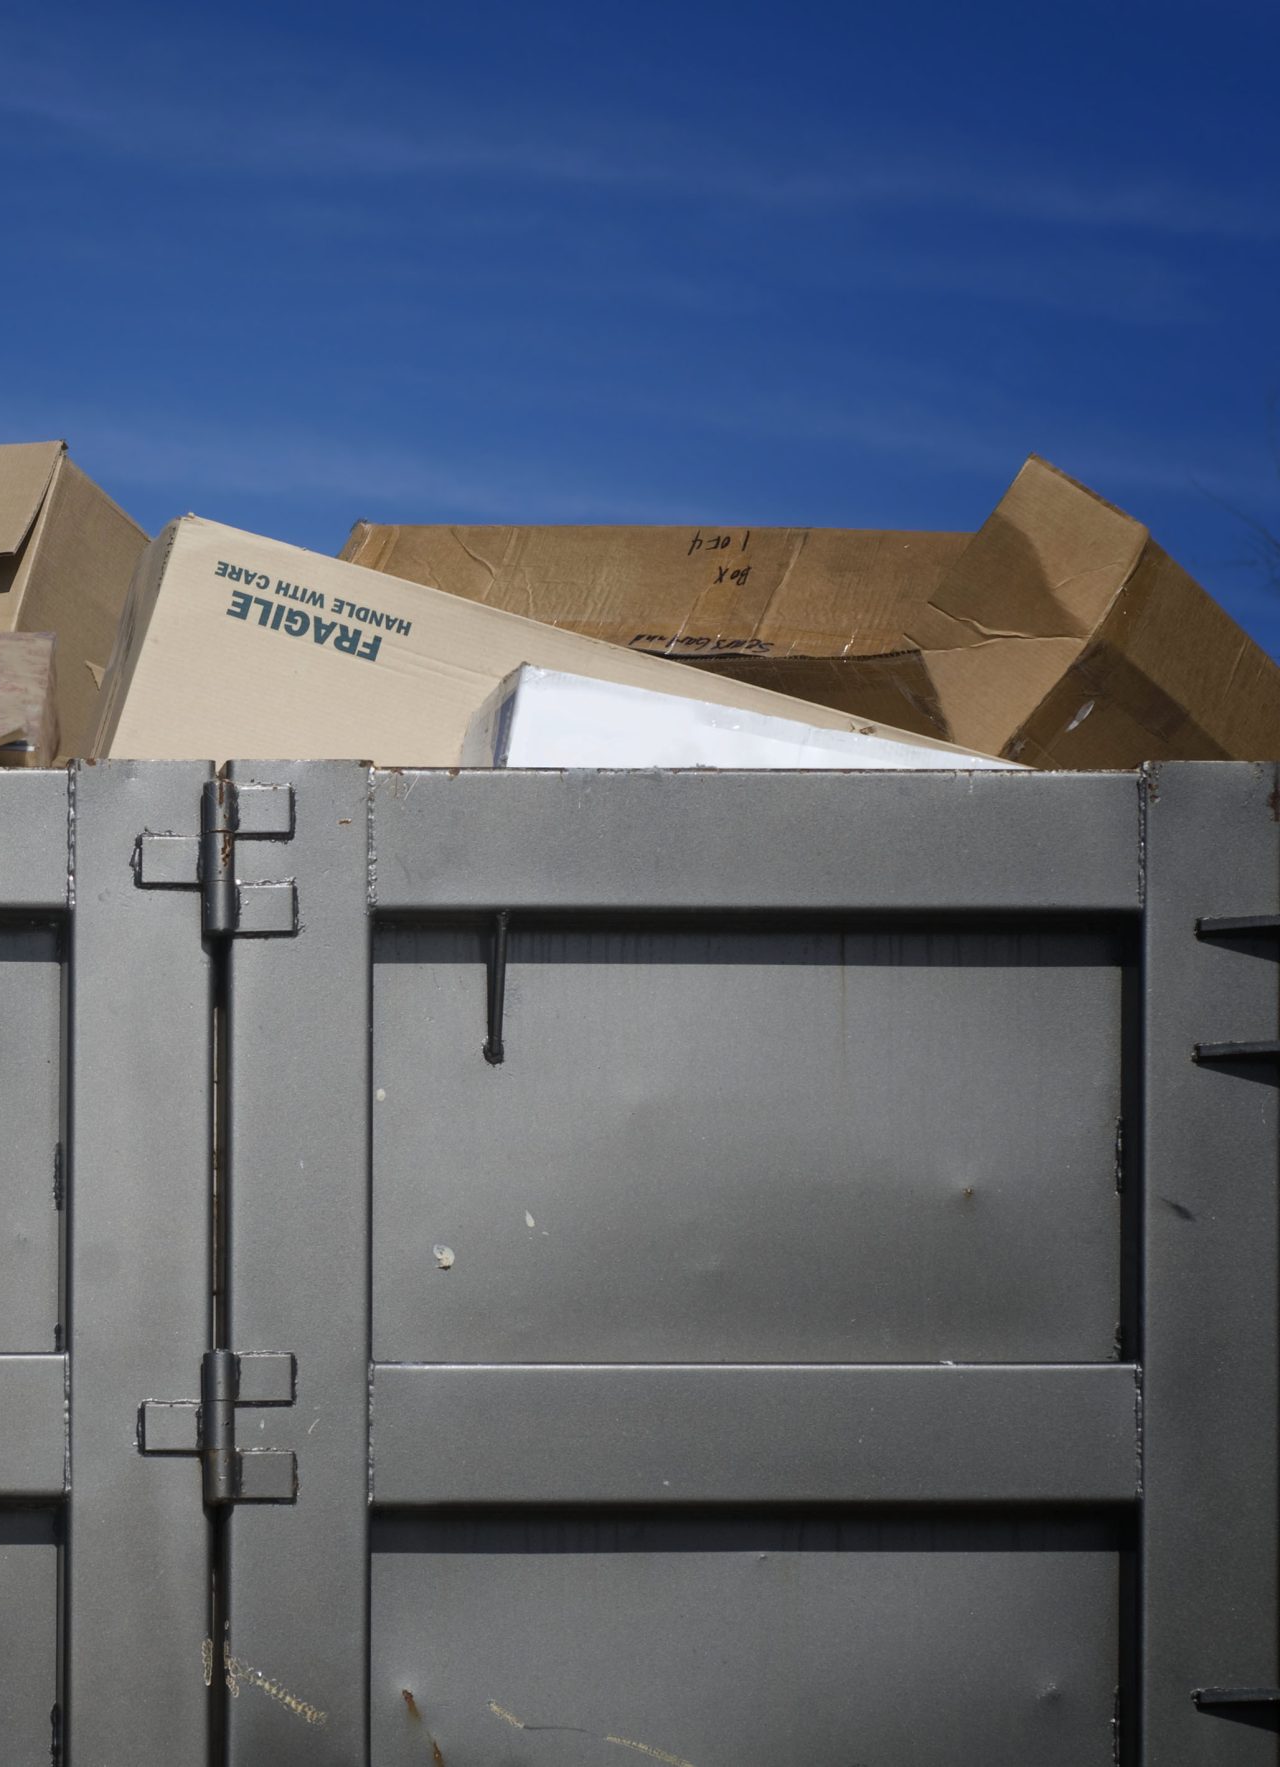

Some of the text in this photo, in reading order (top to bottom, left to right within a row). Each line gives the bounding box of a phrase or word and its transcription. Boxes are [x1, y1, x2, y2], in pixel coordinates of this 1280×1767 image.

[687, 530, 703, 556] 4
[741, 530, 750, 552] 1
[214, 561, 412, 636] HANDLE WITH CARE
[226, 590, 382, 662] FRAGILE
